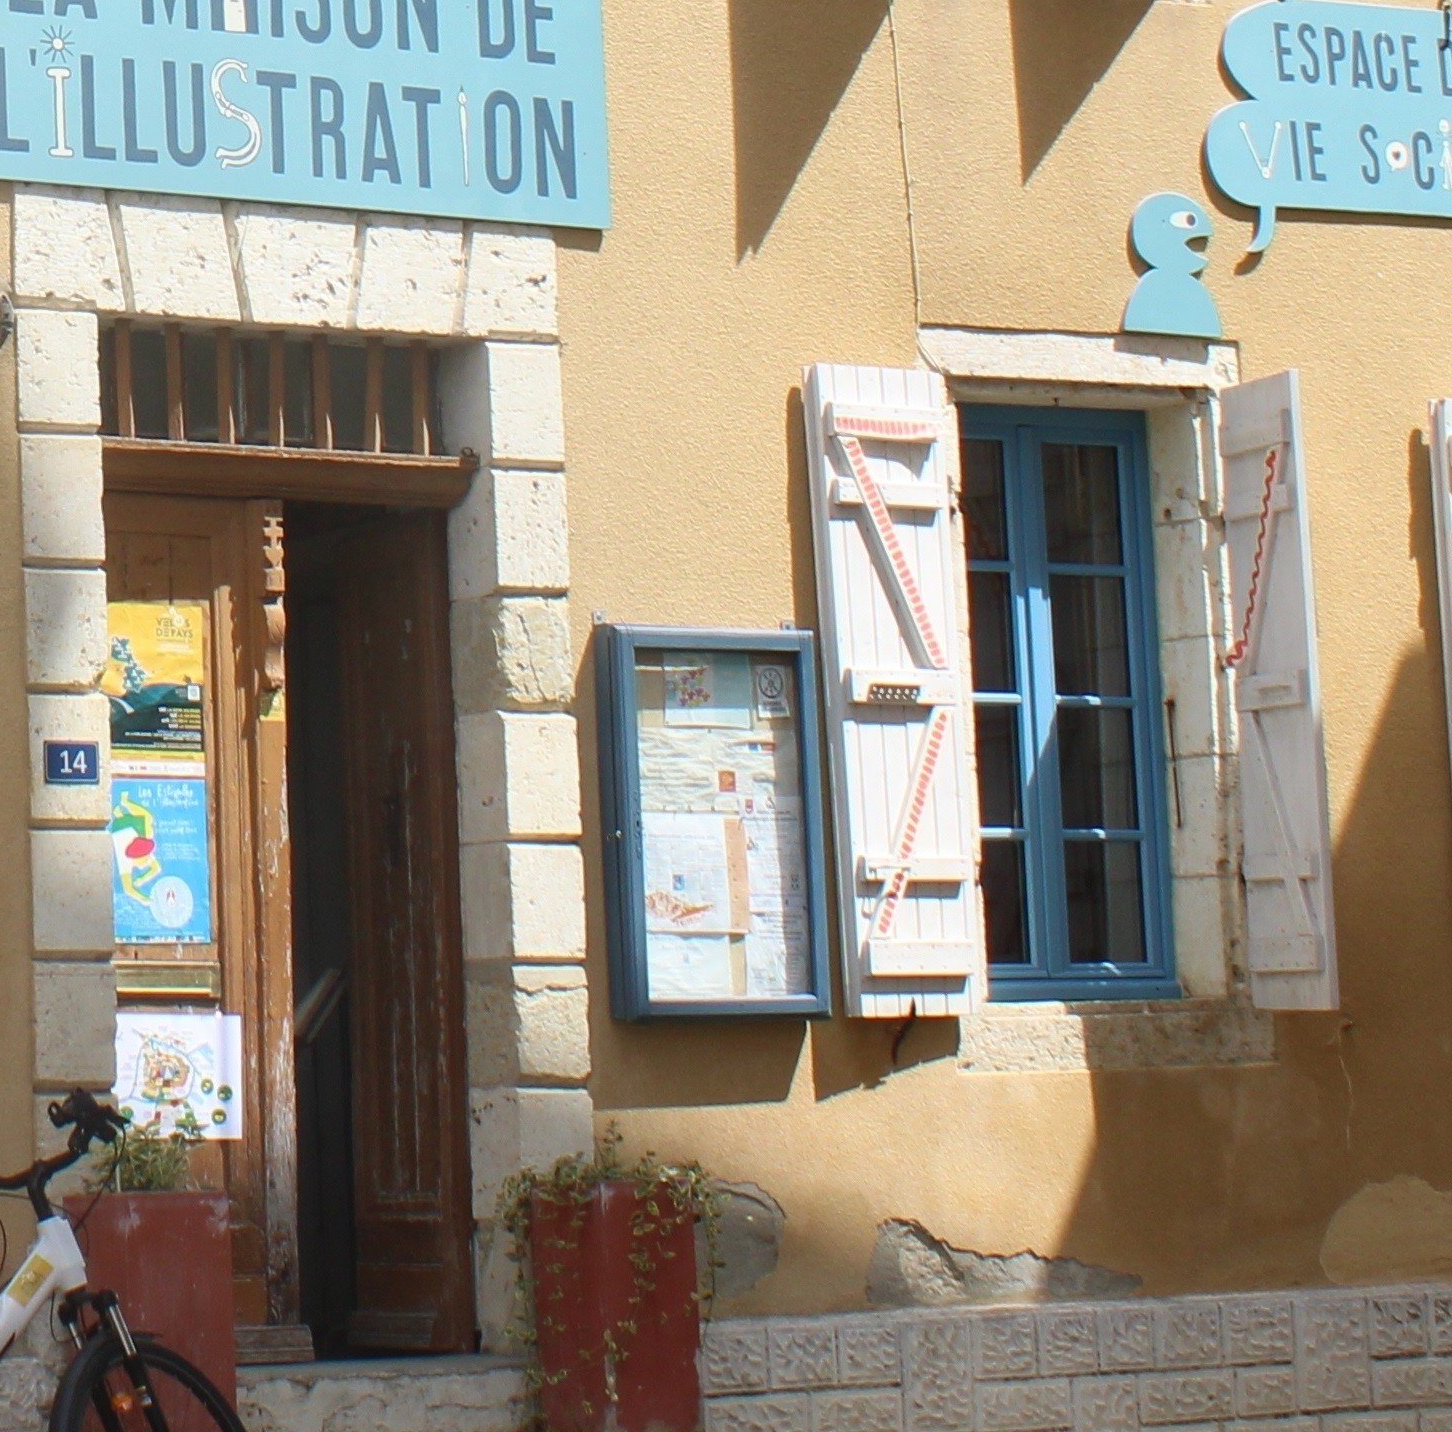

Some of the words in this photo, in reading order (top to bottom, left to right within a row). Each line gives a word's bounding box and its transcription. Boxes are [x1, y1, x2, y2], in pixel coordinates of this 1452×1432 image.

[1272, 21, 1423, 95] ESPACE
[1238, 119, 1328, 182] VIE
[59, 749, 88, 774] 14
